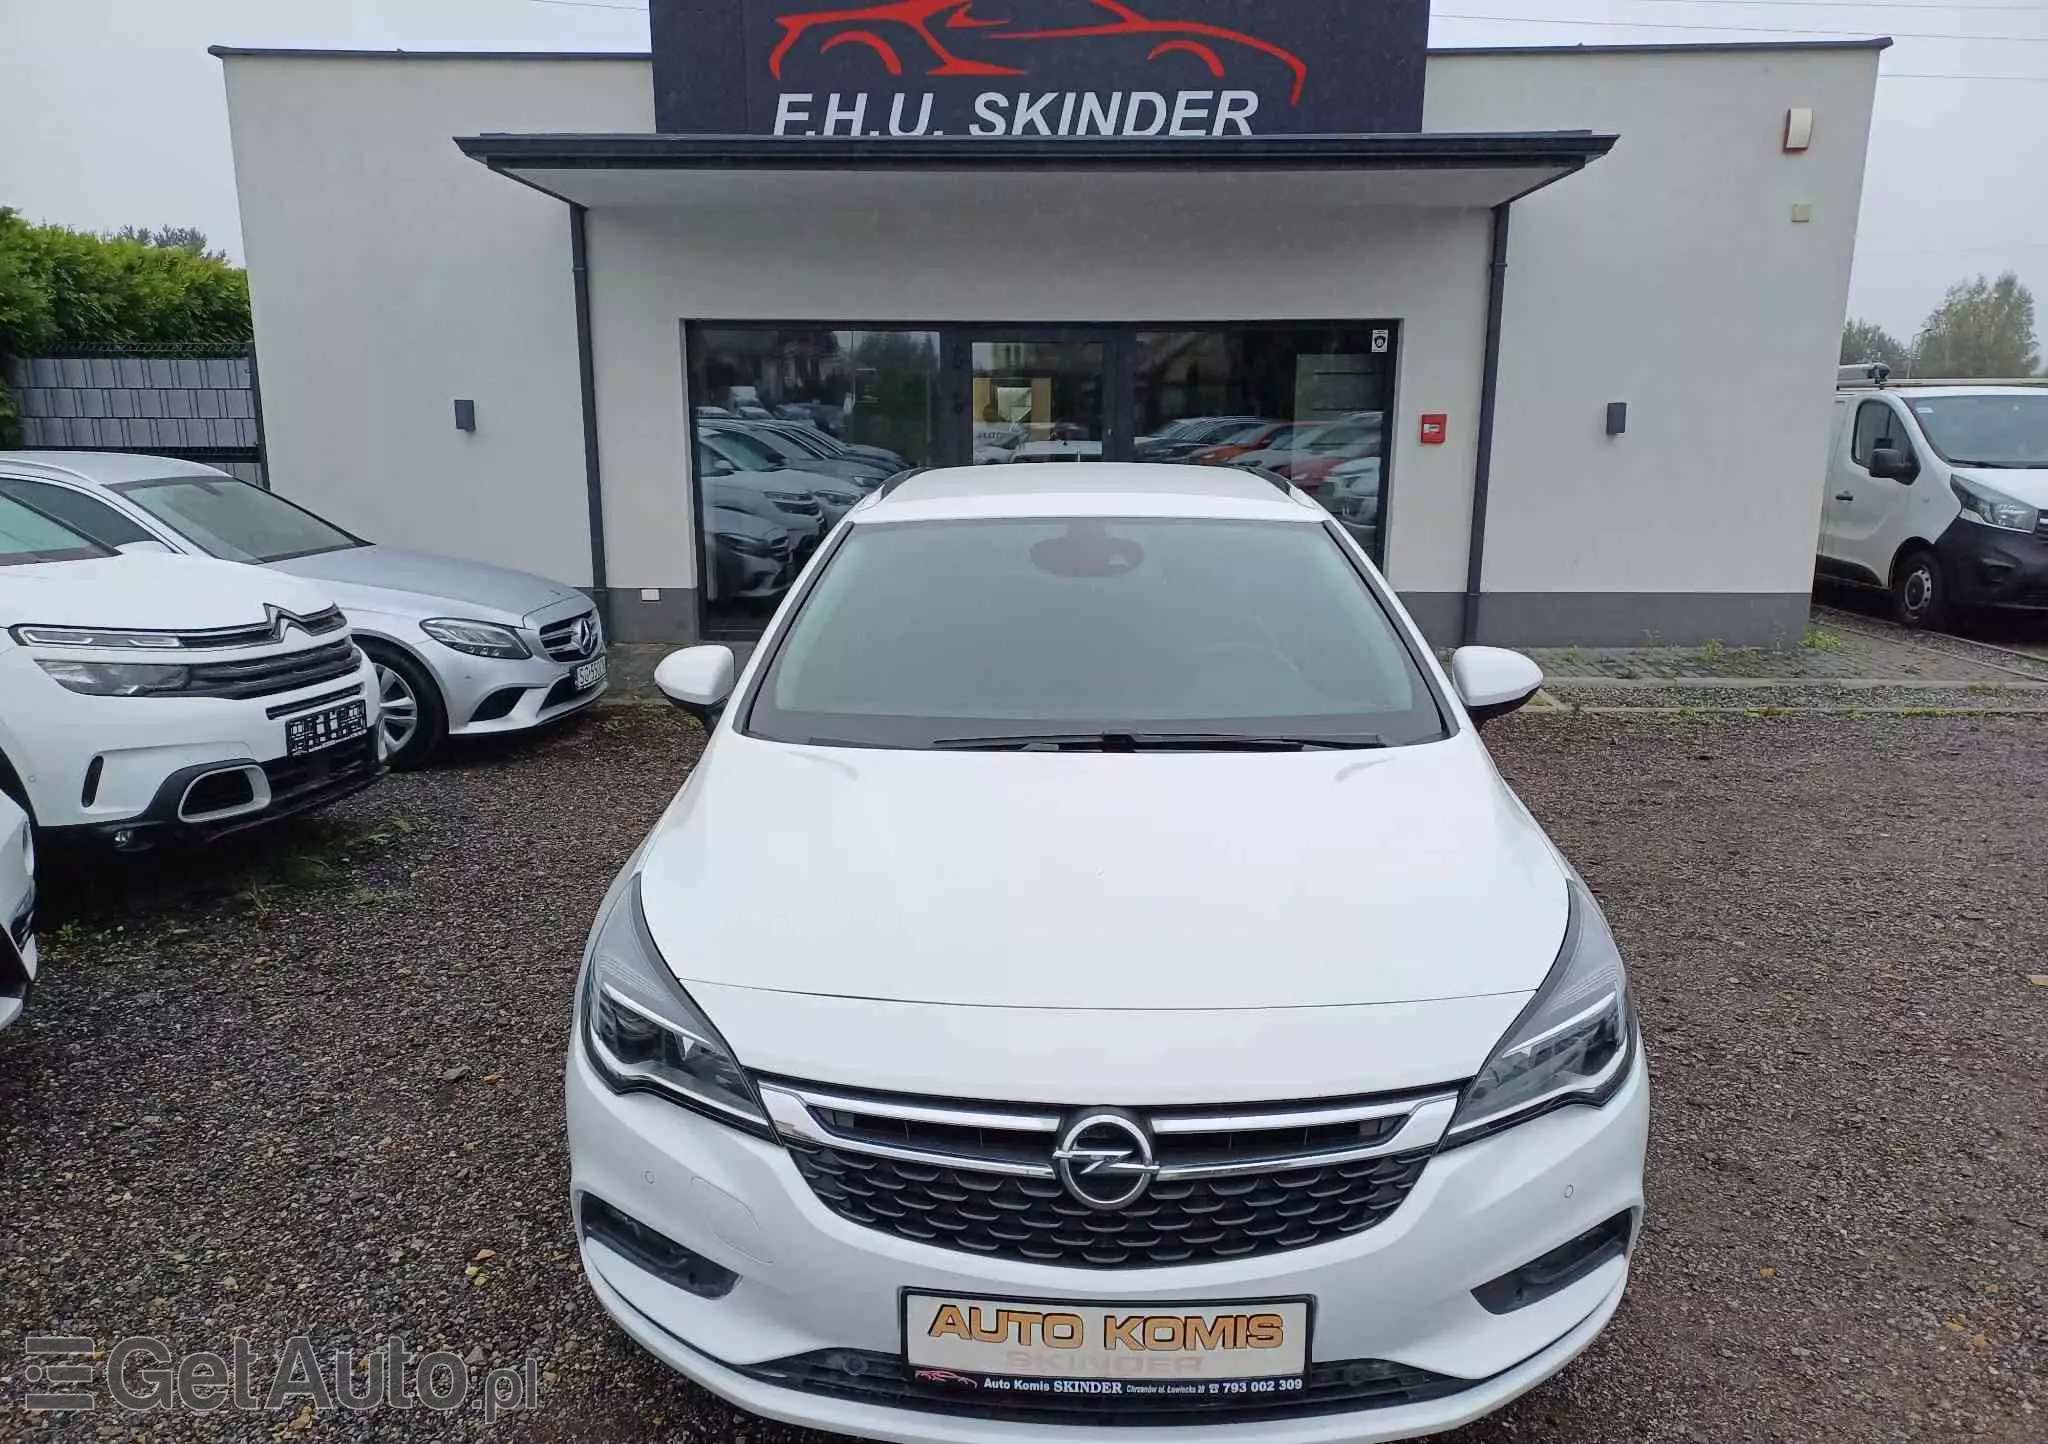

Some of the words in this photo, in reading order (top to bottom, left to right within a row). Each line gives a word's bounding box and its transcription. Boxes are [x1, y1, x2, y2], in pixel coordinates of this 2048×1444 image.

[773, 92, 944, 136] F.H.U.
[968, 90, 1259, 136] SKINDER
[928, 1304, 1083, 1350] AUTO
[1104, 1314, 1284, 1351] KOMIS
[1005, 1350, 1204, 1374] SKINDER
[984, 1378, 1010, 1389] Auto
[1014, 1380, 1050, 1391] Komis
[1054, 1381, 1122, 1393] SKINDER
[1222, 1383, 1247, 1393] 793
[1250, 1381, 1275, 1392] 002
[1279, 1378, 1303, 1390] 309
